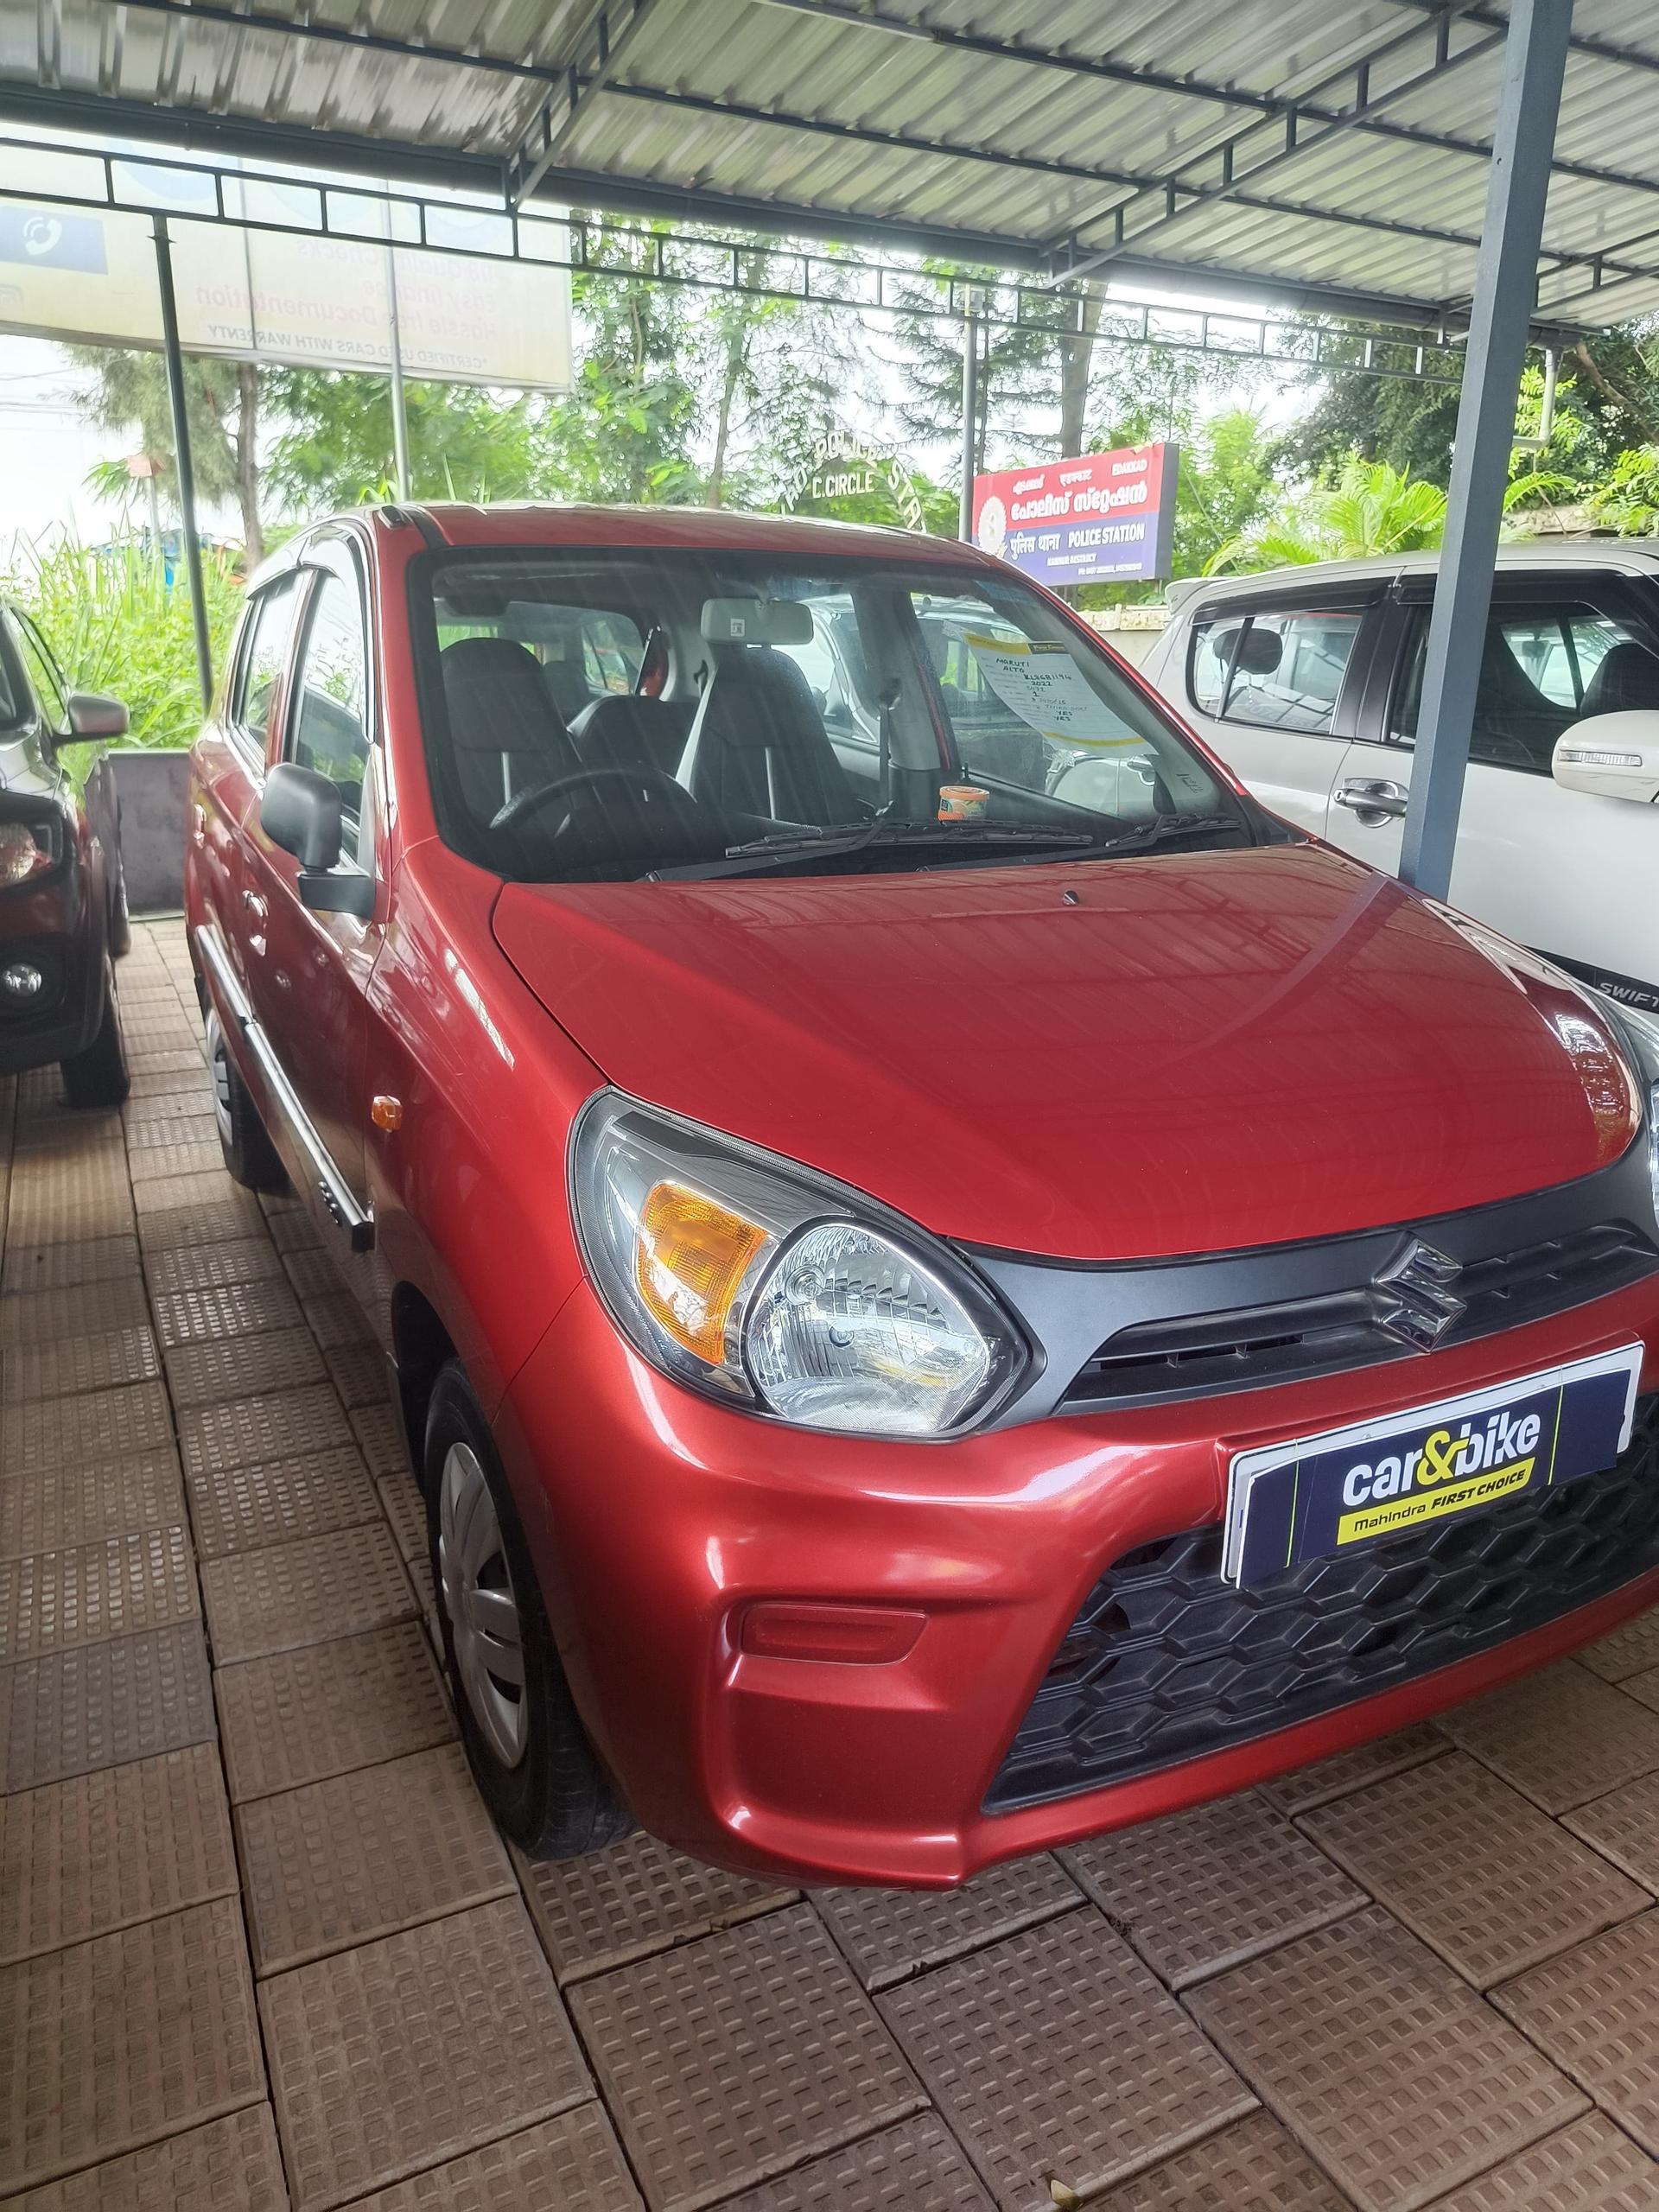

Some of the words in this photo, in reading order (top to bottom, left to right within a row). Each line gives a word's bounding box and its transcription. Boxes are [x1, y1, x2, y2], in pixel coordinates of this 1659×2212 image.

[1068, 527, 1102, 548] POLICE
[1102, 523, 1145, 544] STATION
[995, 658, 1030, 667] MARUTI
[1597, 982, 1659, 1007] SWIFT
[1342, 1410, 1541, 1507] car&bike
[1354, 1503, 1427, 1533] Mahindra
[1431, 1486, 1476, 1511] FIRST
[1477, 1468, 1527, 1497] CHOICE
